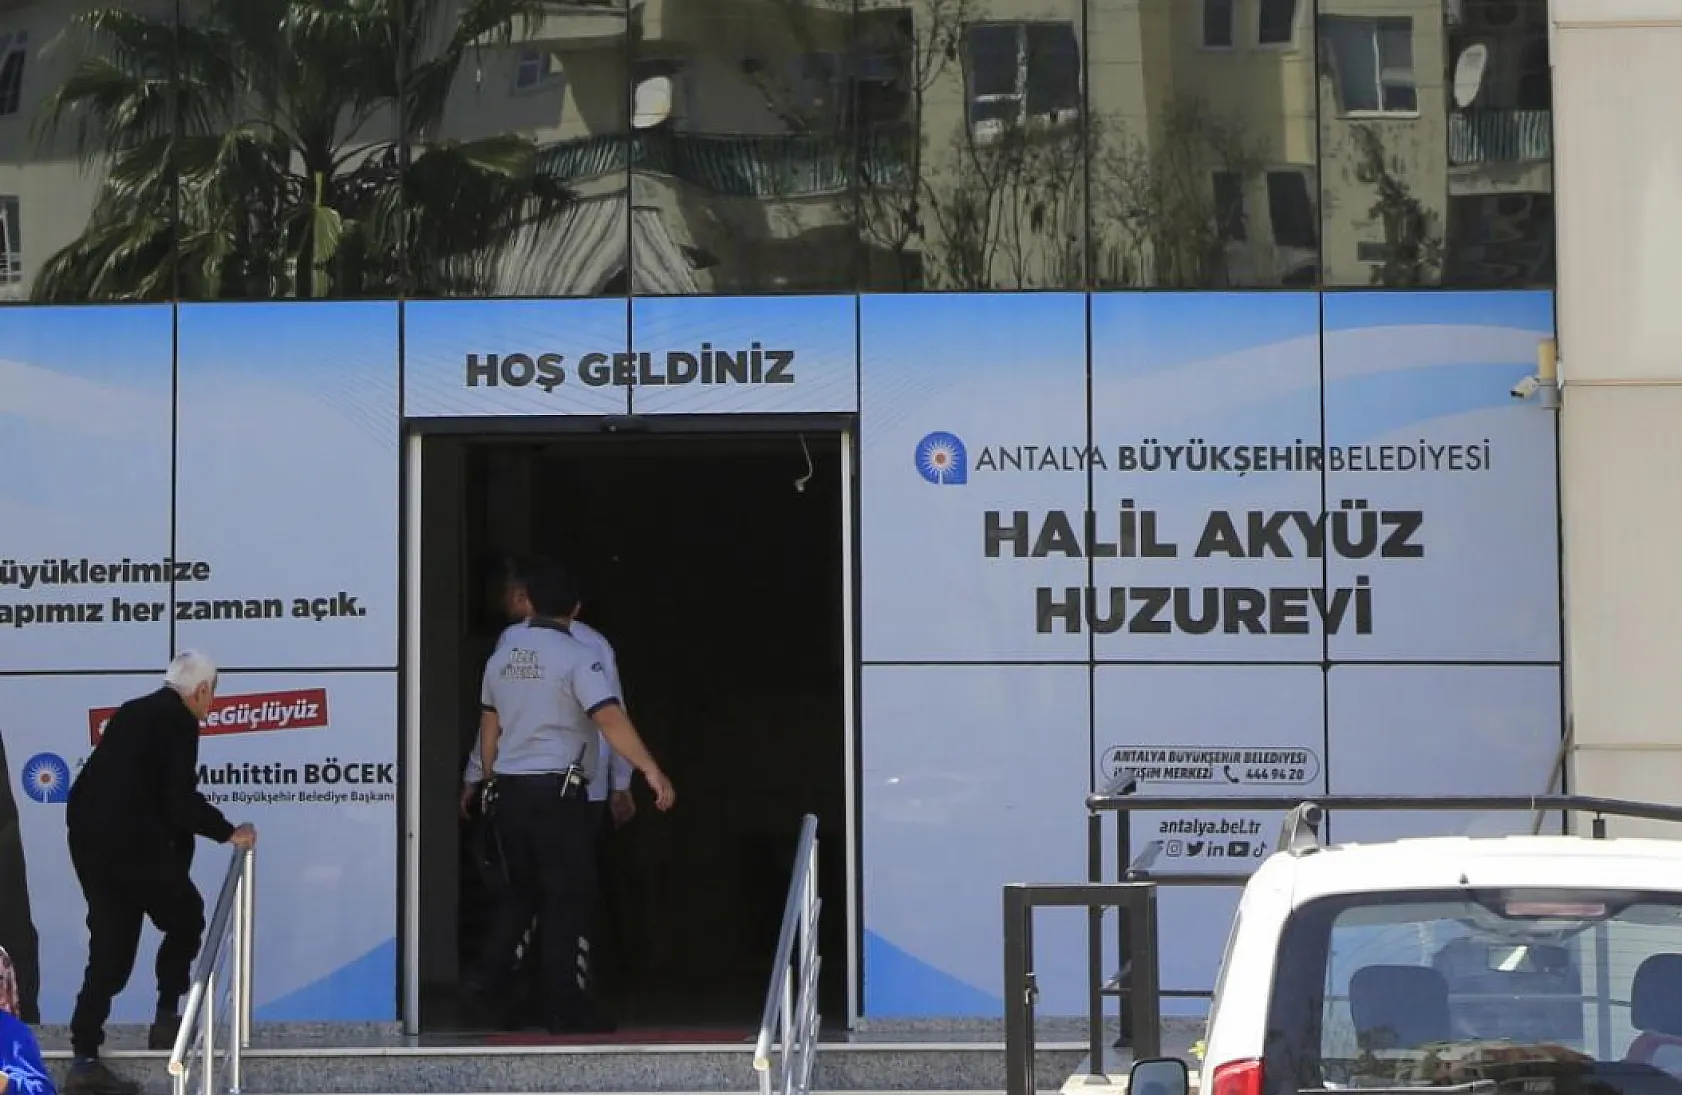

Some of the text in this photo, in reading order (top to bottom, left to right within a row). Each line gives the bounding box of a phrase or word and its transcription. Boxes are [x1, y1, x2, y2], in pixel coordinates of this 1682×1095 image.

[466, 341, 795, 393] HOŞ GELDİNİZ
[974, 438, 1492, 477] ANTALYA BÜYÜKŞEHİR BELEDİYESİ
[984, 499, 1425, 558] HALİL AKYÜZ
[0, 558, 210, 589] üyüklerimize
[0, 592, 367, 627] apımız her zaman açık.
[1036, 575, 1373, 634] HUZUREVİ
[304, 757, 394, 785] BÖCEK
[1113, 750, 1166, 763] ANTALYA
[1246, 768, 1268, 780] 444
[299, 790, 348, 805] Belediye
[1159, 818, 1262, 837] antalya.bel.tr
